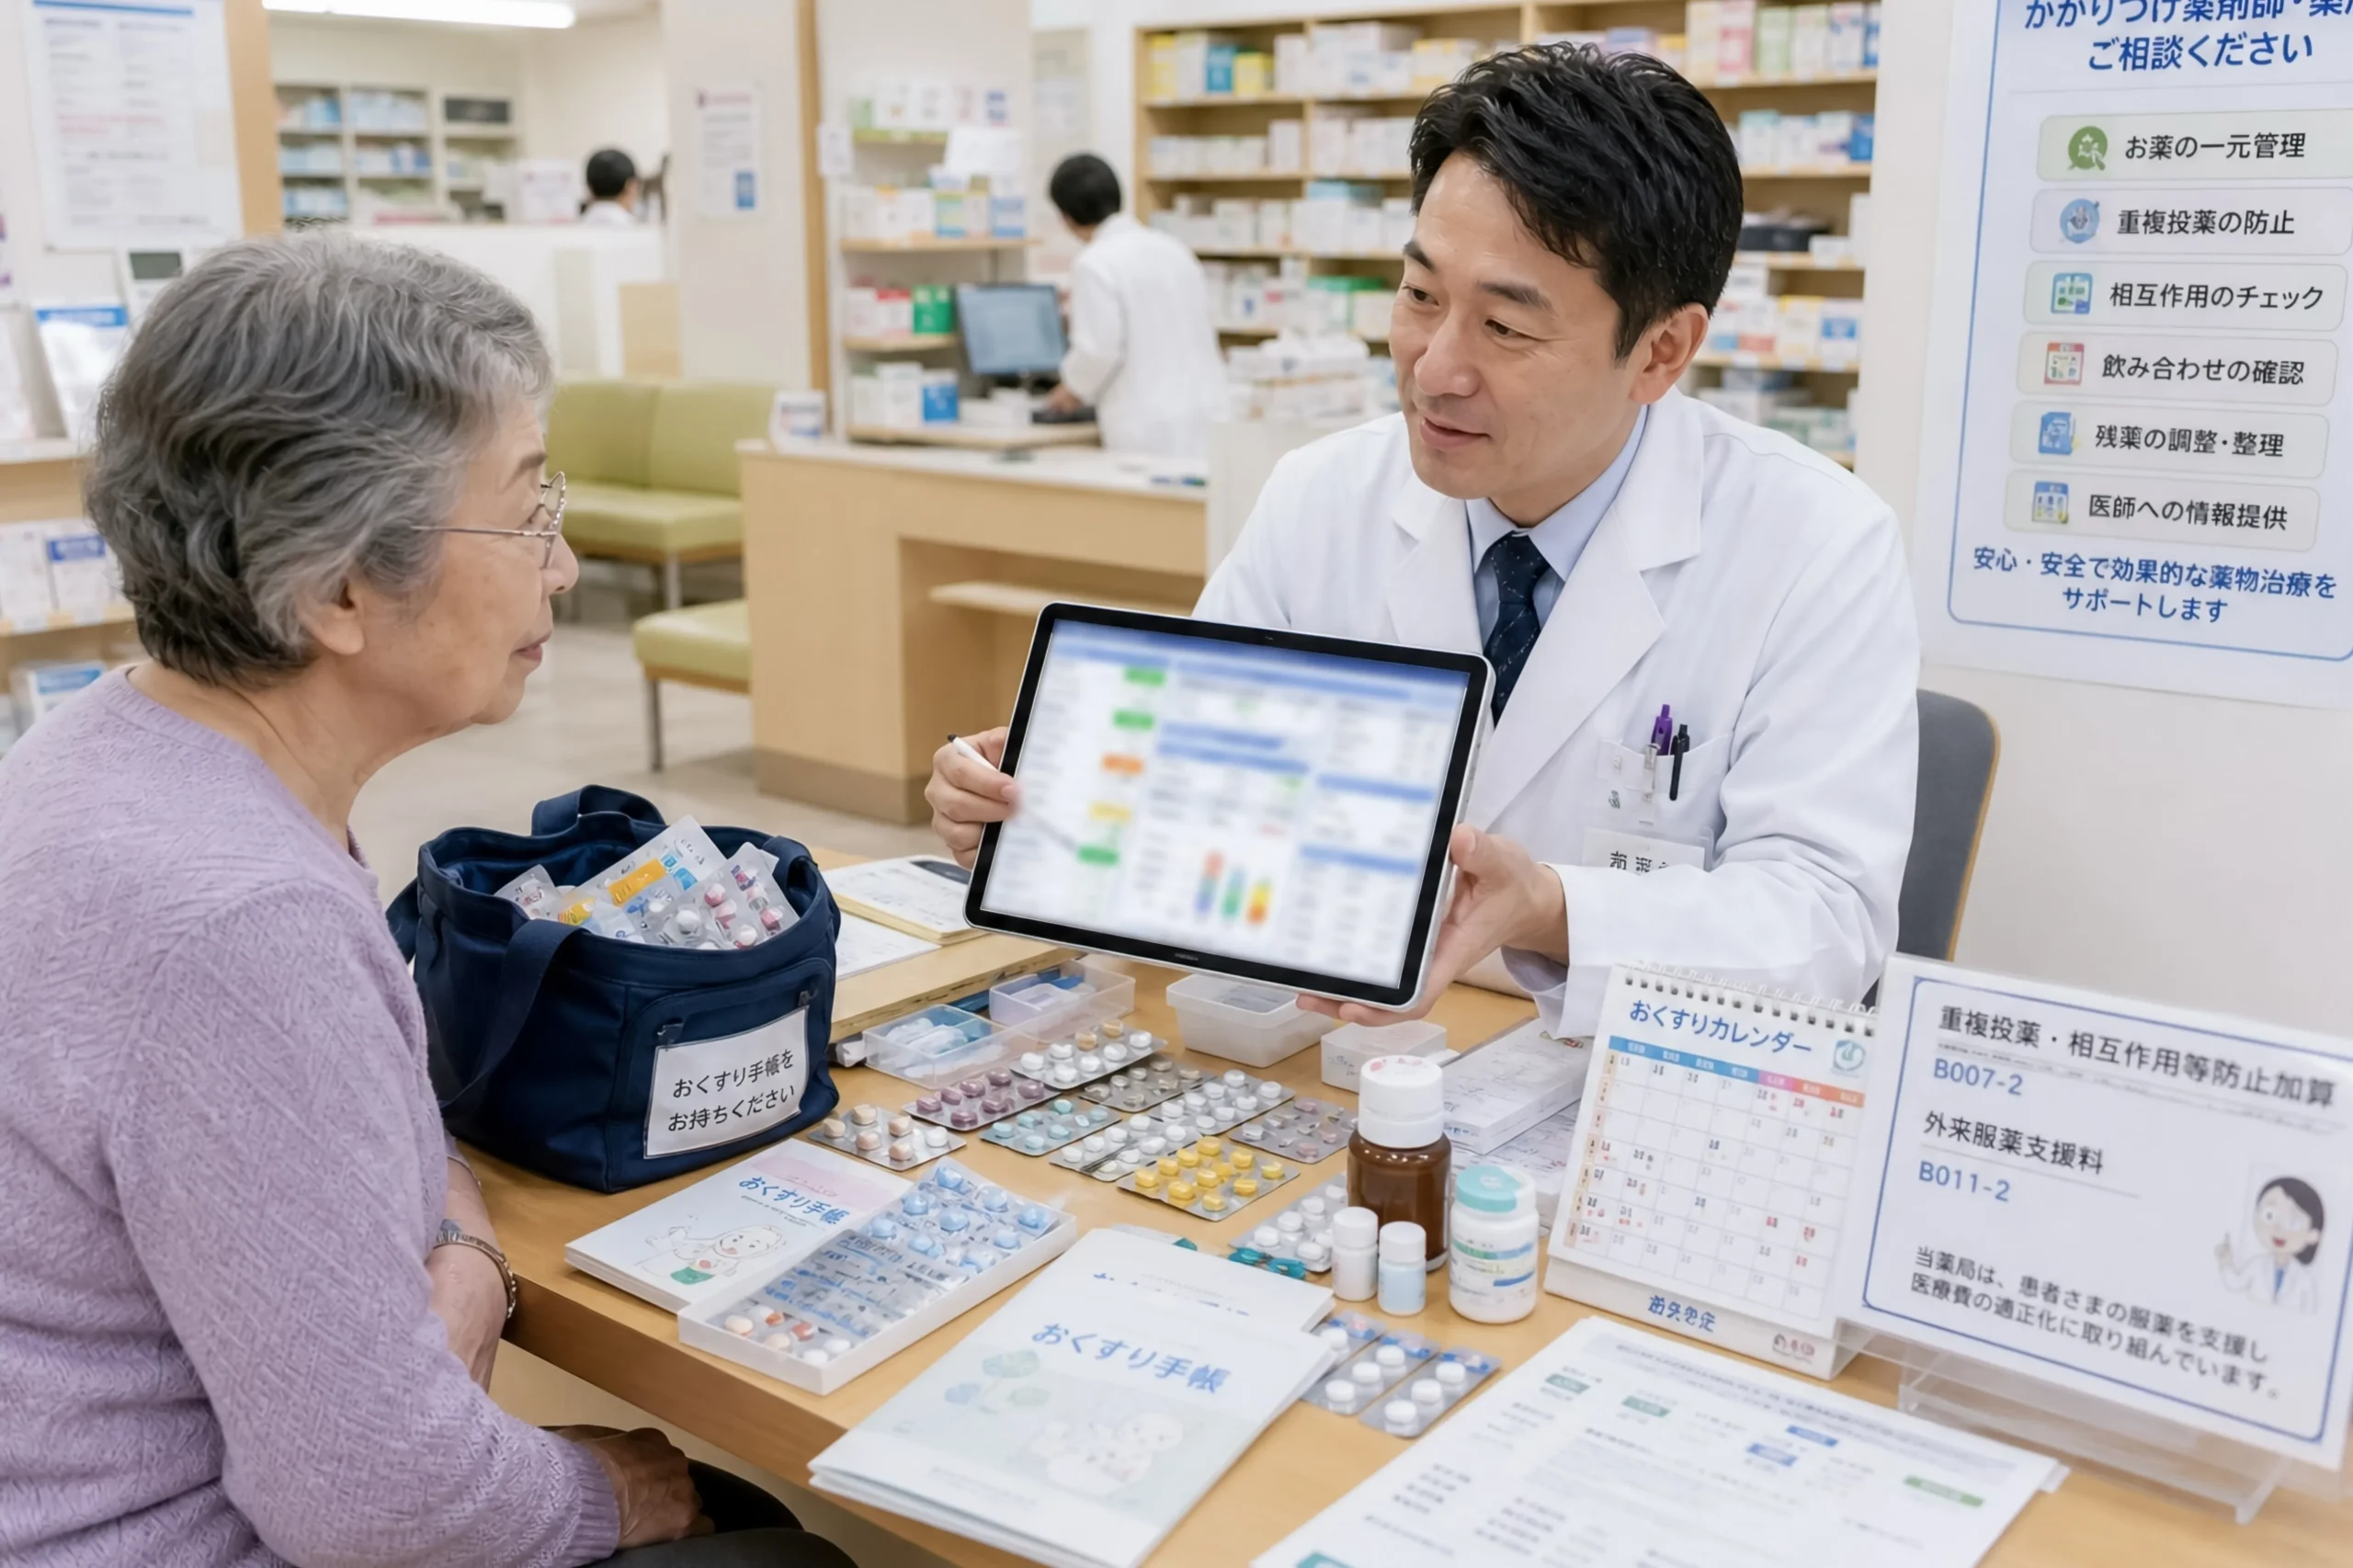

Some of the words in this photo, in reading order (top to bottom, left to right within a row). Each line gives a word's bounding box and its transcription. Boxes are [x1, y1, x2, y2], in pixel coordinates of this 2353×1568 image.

[2025, 0, 2353, 28] かかりつけ薬剤師・
[2089, 32, 2313, 71] ご相談ください
[2125, 132, 2306, 160] お薬の一元管理
[2117, 210, 2295, 236] 重複投薬の防止
[2109, 283, 2324, 310] 相互作用のチェック
[2102, 355, 2304, 385] 飲み合わせの確認
[2095, 425, 2285, 458] 残薬の調整・整理
[2088, 494, 2288, 530] 医師への情報提供
[1973, 547, 2337, 599] 安心・安全で効果的な薬物治療を
[2063, 587, 2228, 623] サポートします
[1630, 1000, 1812, 1053] おくすりカレンダー
[673, 1049, 794, 1098] おくすり手帳を
[1934, 1058, 2023, 1096] B007-2
[1938, 1006, 2338, 1110] 重複投薬・相互作用等防止加算
[668, 1085, 795, 1131] お持ちください
[1923, 1110, 2104, 1175] 外来服薬支援料
[1918, 1161, 2011, 1201] B011-2
[1915, 1245, 2269, 1364] 当薬局は、患者さまの服薬を支援し
[1911, 1272, 2280, 1401] 医療費の適正化に取り組んでいます。
